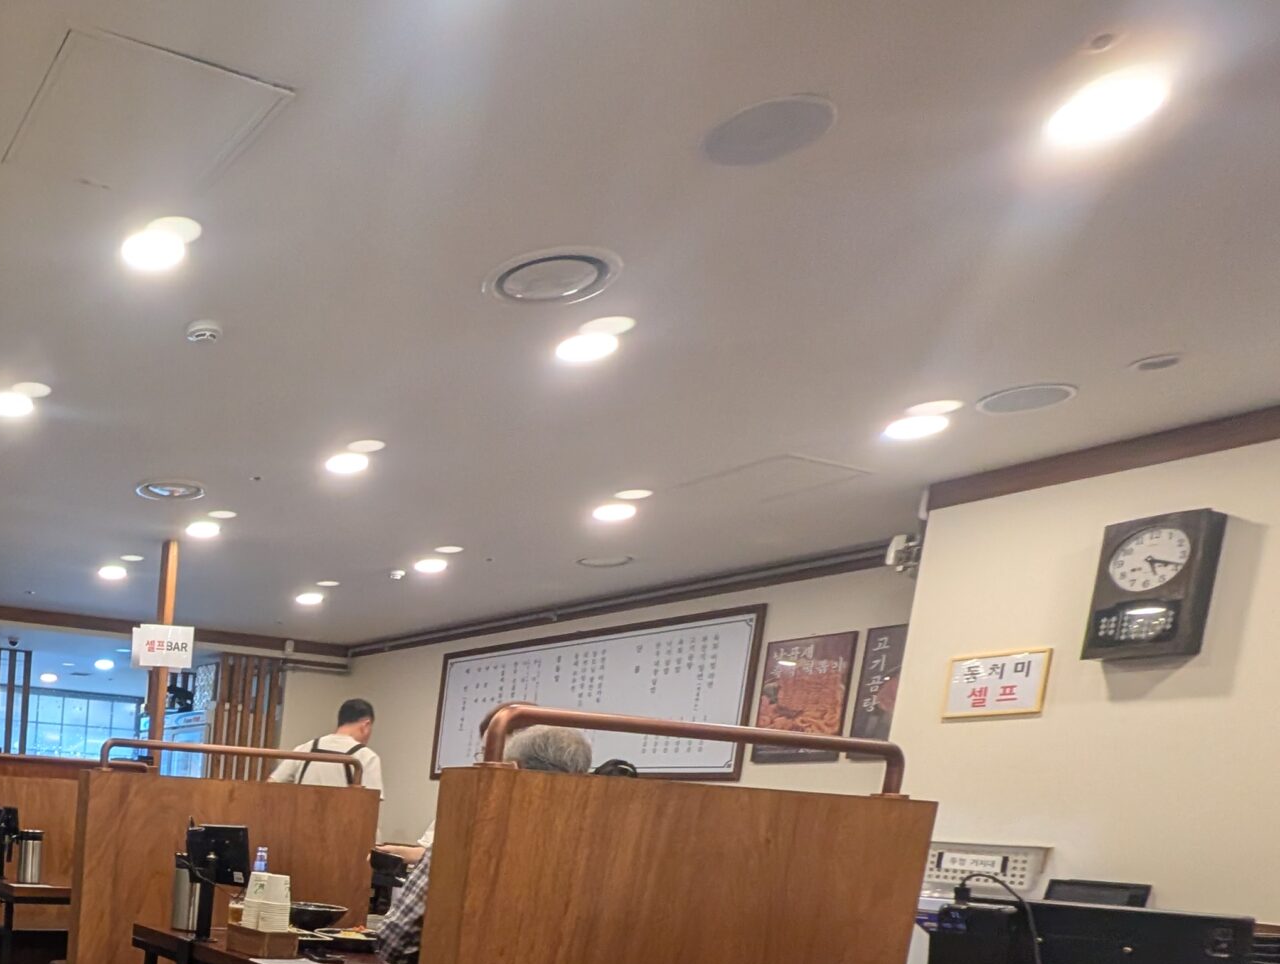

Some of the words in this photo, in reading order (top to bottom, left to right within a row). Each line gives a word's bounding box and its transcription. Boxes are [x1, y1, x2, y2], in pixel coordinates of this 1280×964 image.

[862, 635, 891, 713] 고기곰탕
[963, 660, 1032, 684] 동치미
[967, 685, 1018, 708] 셀프
